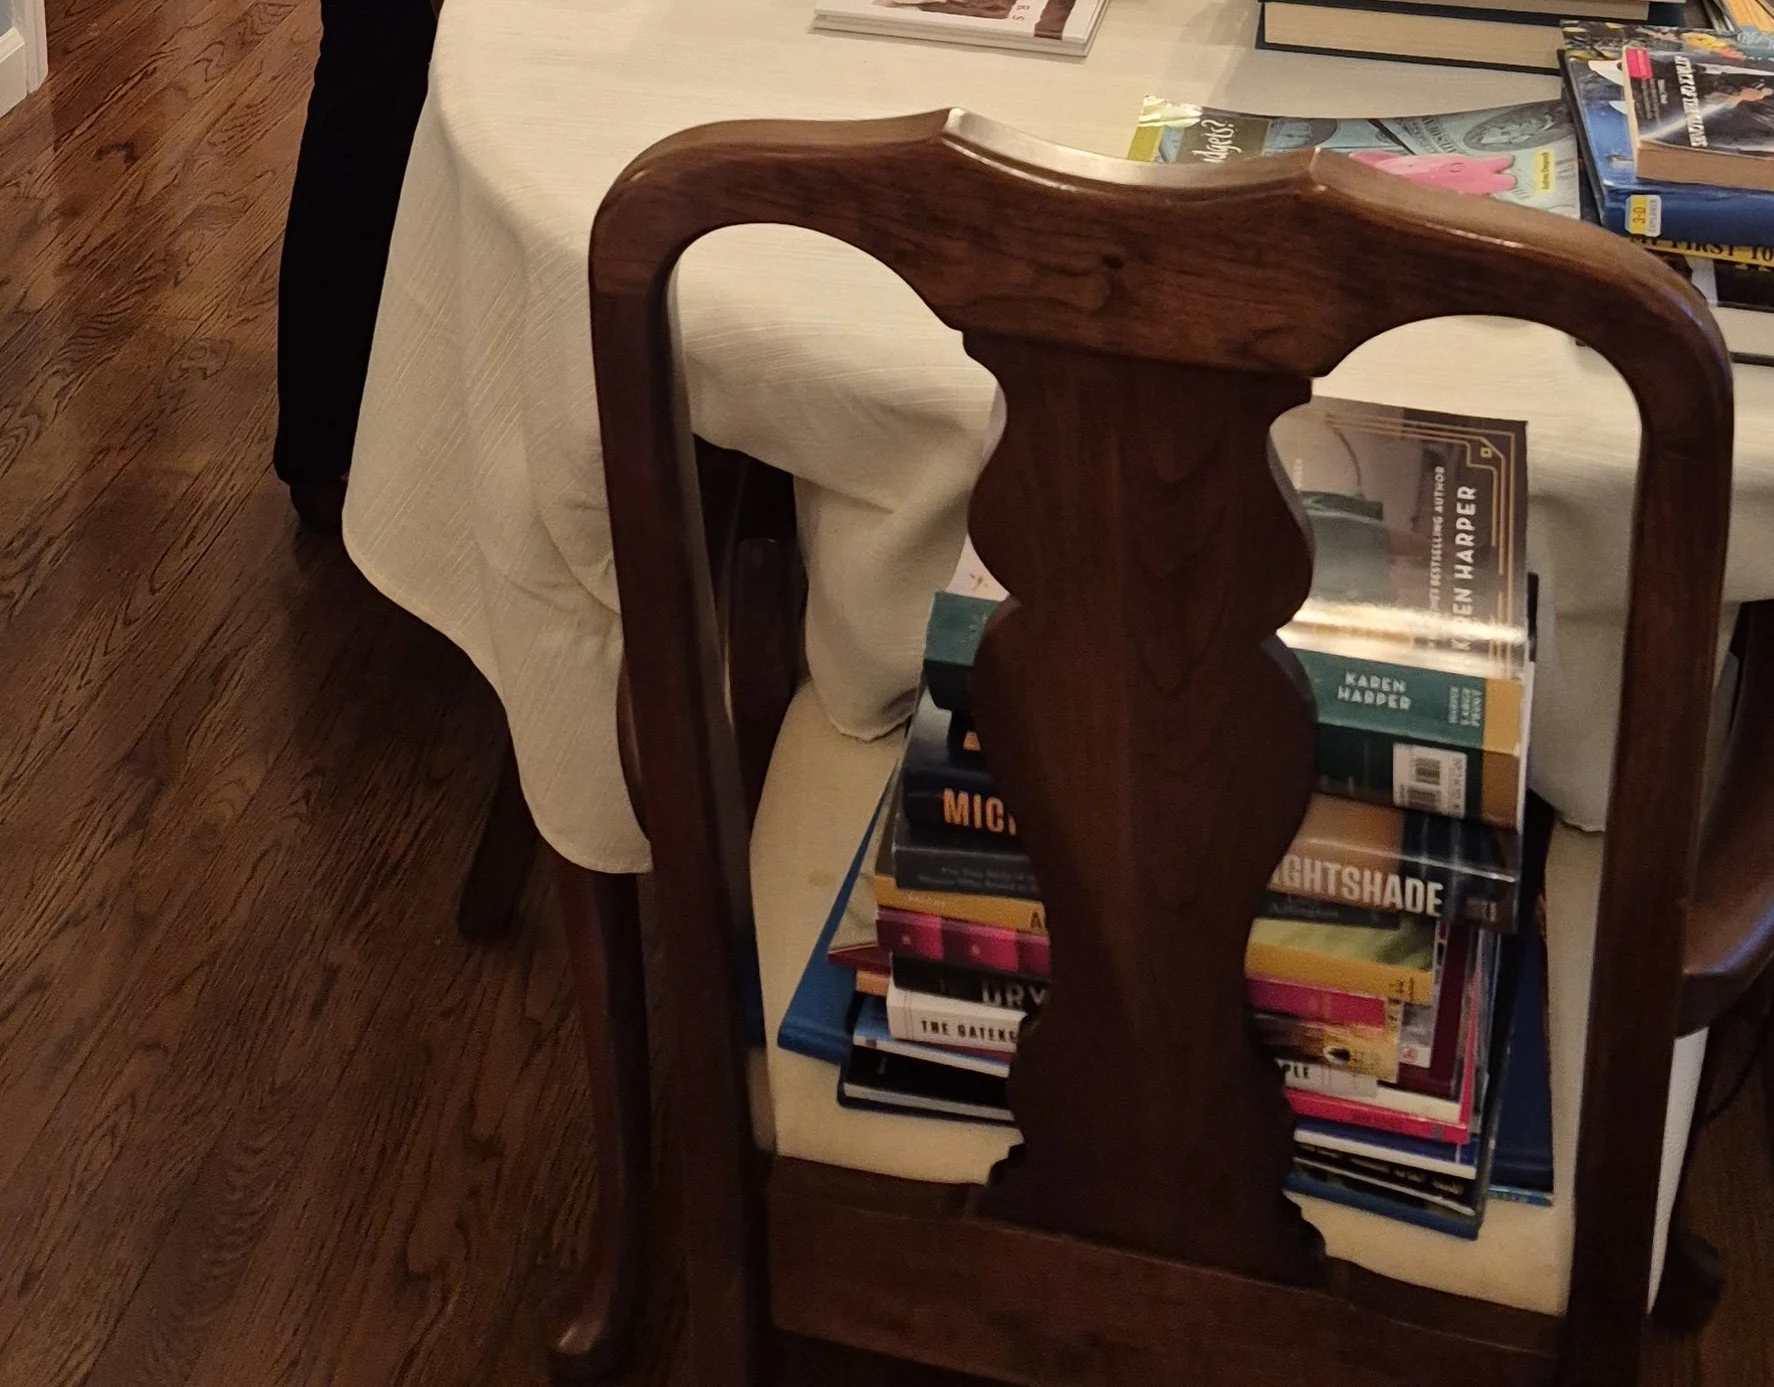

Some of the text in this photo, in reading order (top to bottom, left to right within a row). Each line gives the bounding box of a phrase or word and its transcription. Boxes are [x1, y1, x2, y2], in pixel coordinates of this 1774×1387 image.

[1201, 118, 1234, 163] dgets?
[1632, 206, 1646, 224] 3-D
[1429, 518, 1443, 588] BESTSELLING
[1437, 466, 1446, 514] AUTHOR
[1450, 484, 1479, 652] KREN HARPER
[1345, 671, 1407, 693] KAREN
[1337, 685, 1412, 711] HARPER
[921, 1019, 1018, 1043] THE GATEKE
[1284, 1064, 1310, 1080] PLE
